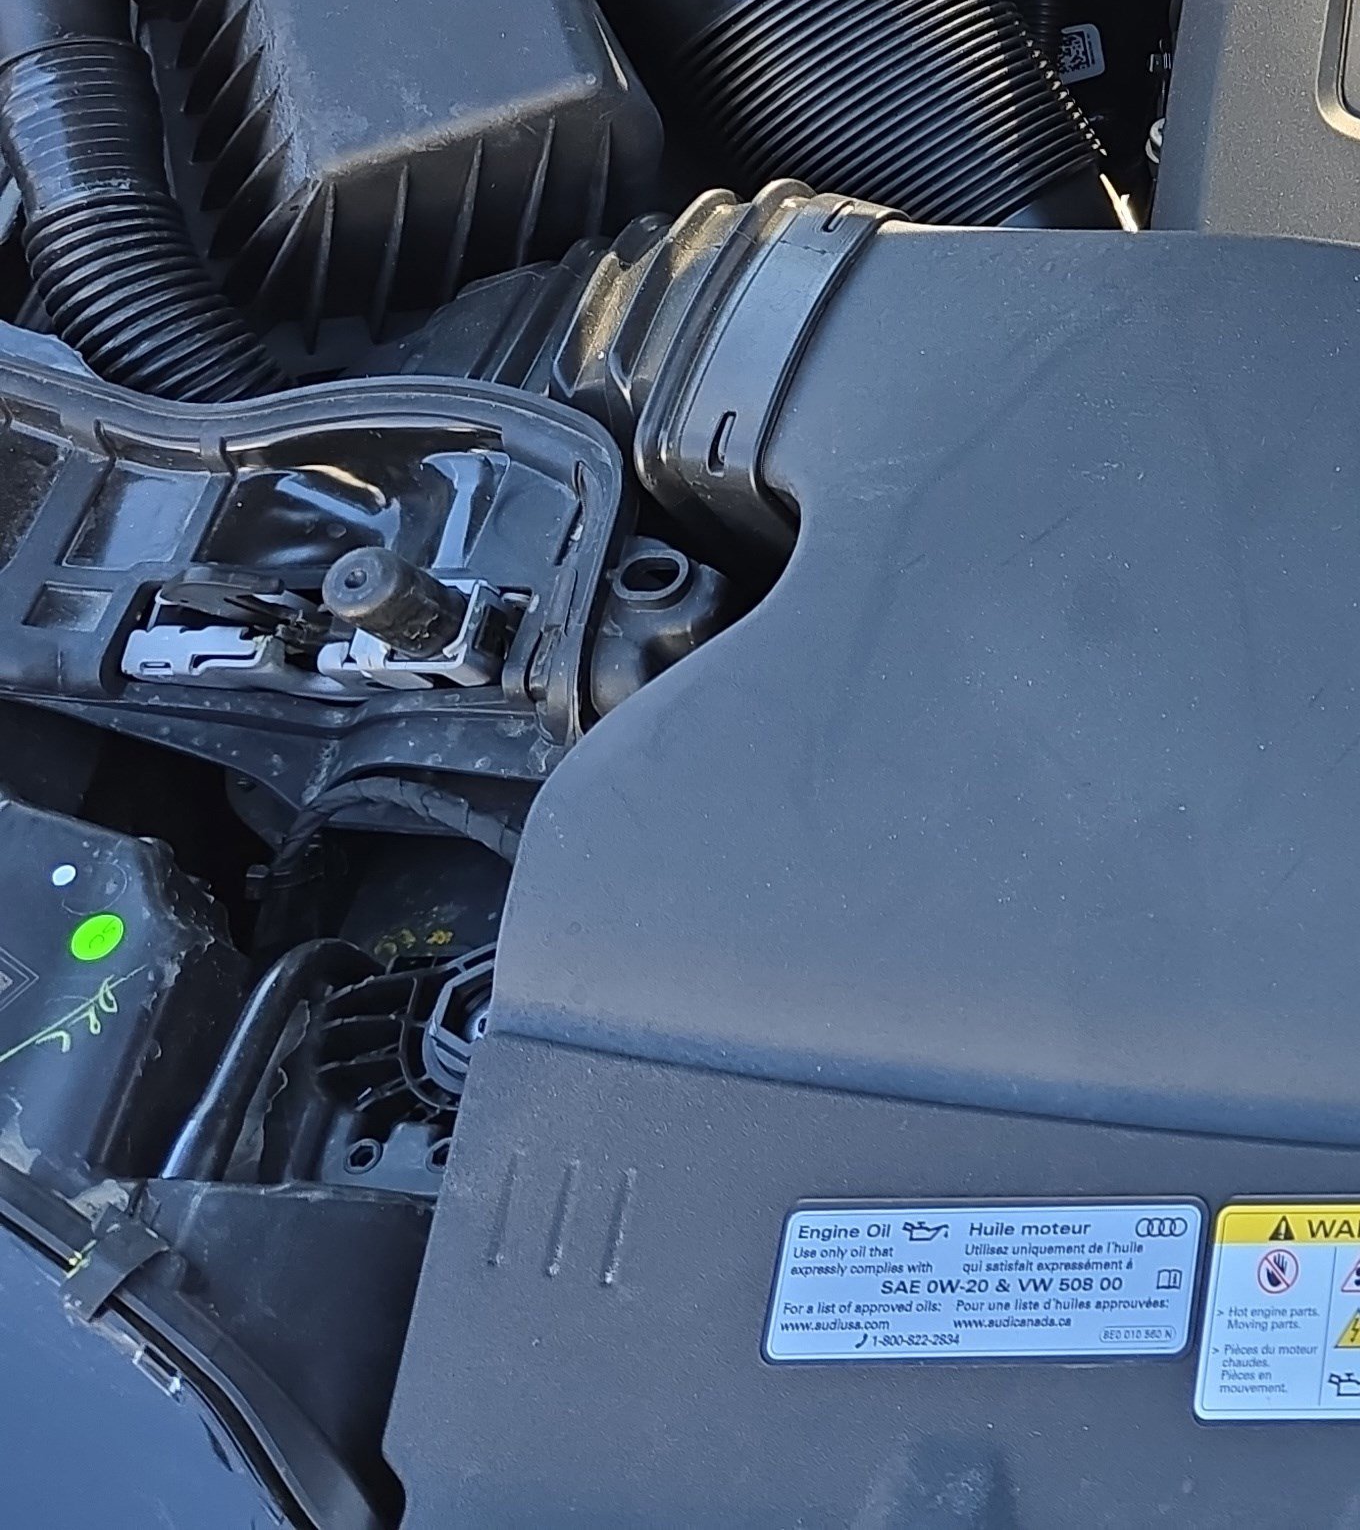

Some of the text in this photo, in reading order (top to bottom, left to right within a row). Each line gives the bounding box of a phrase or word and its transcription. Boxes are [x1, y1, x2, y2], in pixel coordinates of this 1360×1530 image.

[798, 1224, 891, 1241] Engine Oil
[969, 1222, 1091, 1236] Huile moteur
[793, 1246, 894, 1260] Use only oil that
[965, 1241, 1144, 1257] Utilisez uniquement de l'huile
[790, 1262, 933, 1278] expressly complies with
[962, 1261, 982, 1275] qui
[985, 1260, 1034, 1273] satisfait
[1037, 1259, 1123, 1273] expressément
[881, 1277, 1123, 1295] SAE 0W-20 & VW 508 00
[783, 1300, 942, 1316] For a list of approved oils:
[956, 1299, 986, 1312] Pour
[988, 1301, 1011, 1311] une
[1014, 1299, 1039, 1310] liste
[1043, 1298, 1092, 1310] d'huiles
[1228, 1306, 1320, 1319] Hot engine parts.
[780, 1320, 890, 1332] www.audiusa.com
[953, 1316, 1072, 1329] www.audicanada.ca
[1227, 1319, 1268, 1332] Moving
[1261, 1344, 1275, 1355] du
[1279, 1345, 1318, 1355] moteur
[1258, 1372, 1272, 1381] en
